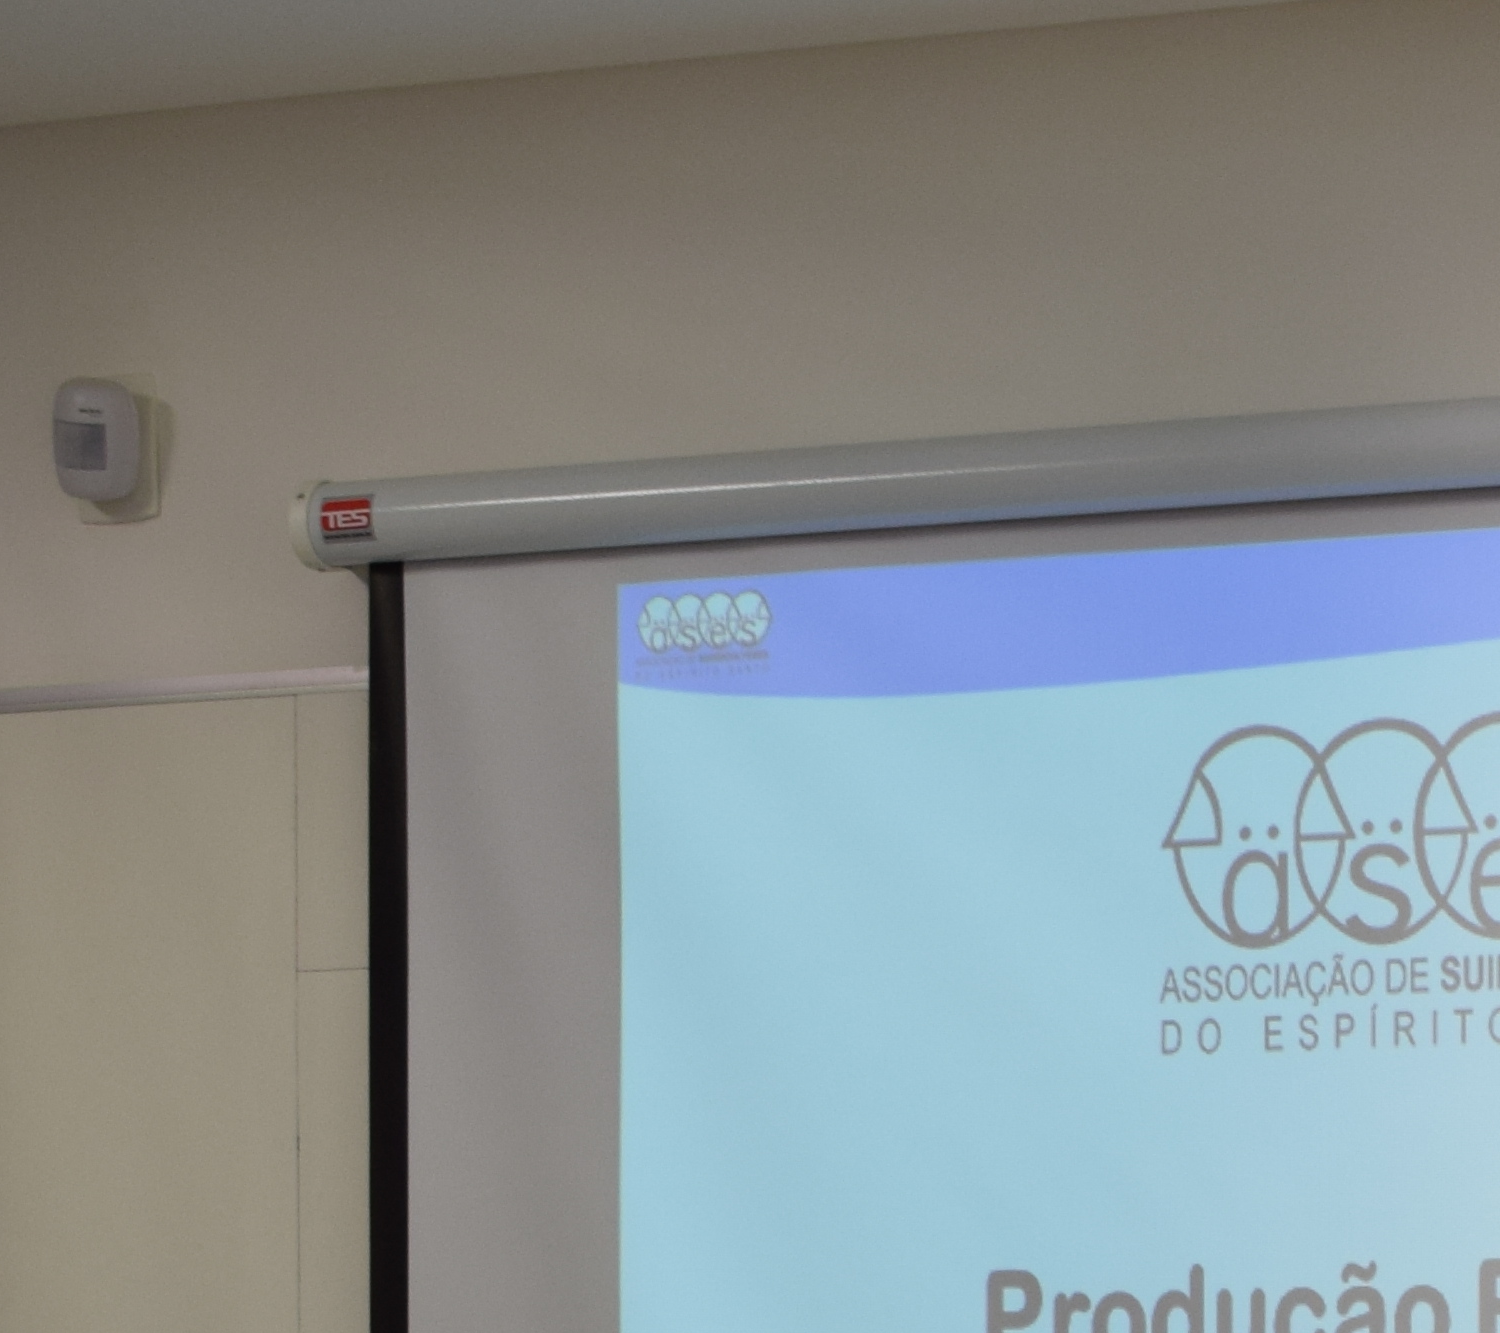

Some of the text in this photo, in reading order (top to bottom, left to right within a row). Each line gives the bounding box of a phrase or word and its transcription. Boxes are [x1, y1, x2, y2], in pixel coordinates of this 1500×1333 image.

[1160, 954, 1373, 1005] ASSOCIAÇÃO
[1387, 957, 1429, 993] DE
[1160, 1017, 1222, 1055] DO
